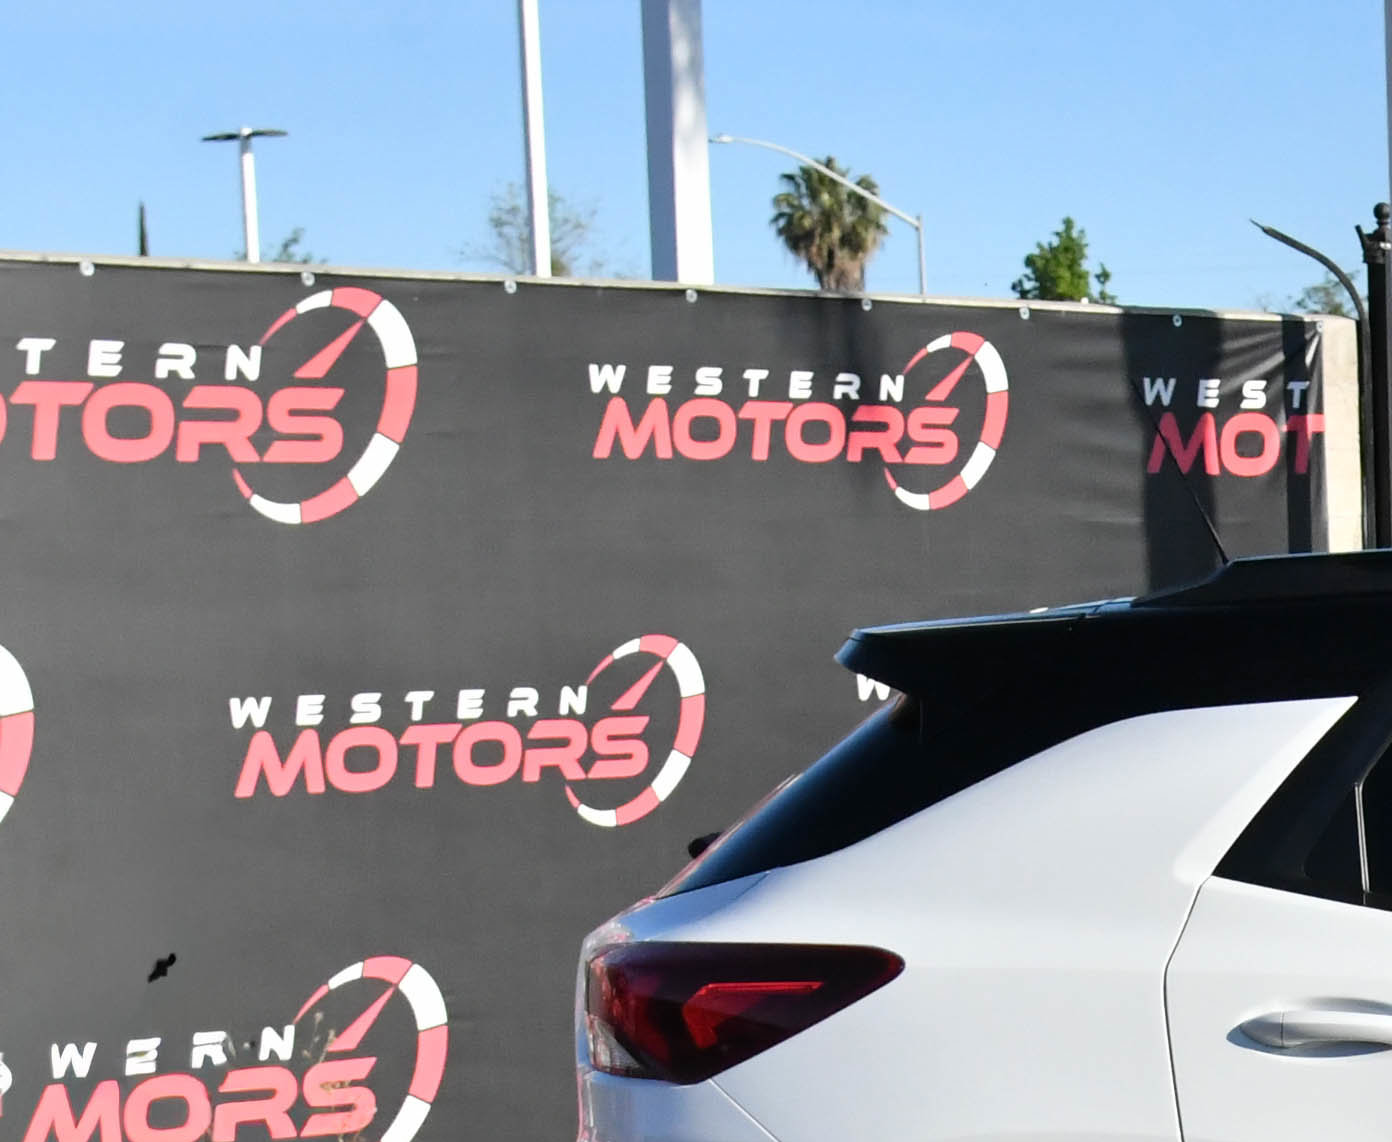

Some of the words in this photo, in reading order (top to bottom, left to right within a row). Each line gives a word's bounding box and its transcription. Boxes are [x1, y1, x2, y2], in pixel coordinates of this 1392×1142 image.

[16, 338, 262, 381] TERN
[589, 364, 905, 402] WESTERN
[1143, 377, 1310, 409] WEST
[0, 380, 345, 464] TORS
[592, 396, 960, 465] MOTORS
[1147, 411, 1325, 478] MOT
[229, 685, 587, 729] WESTERN
[234, 715, 650, 799] MOTORS
